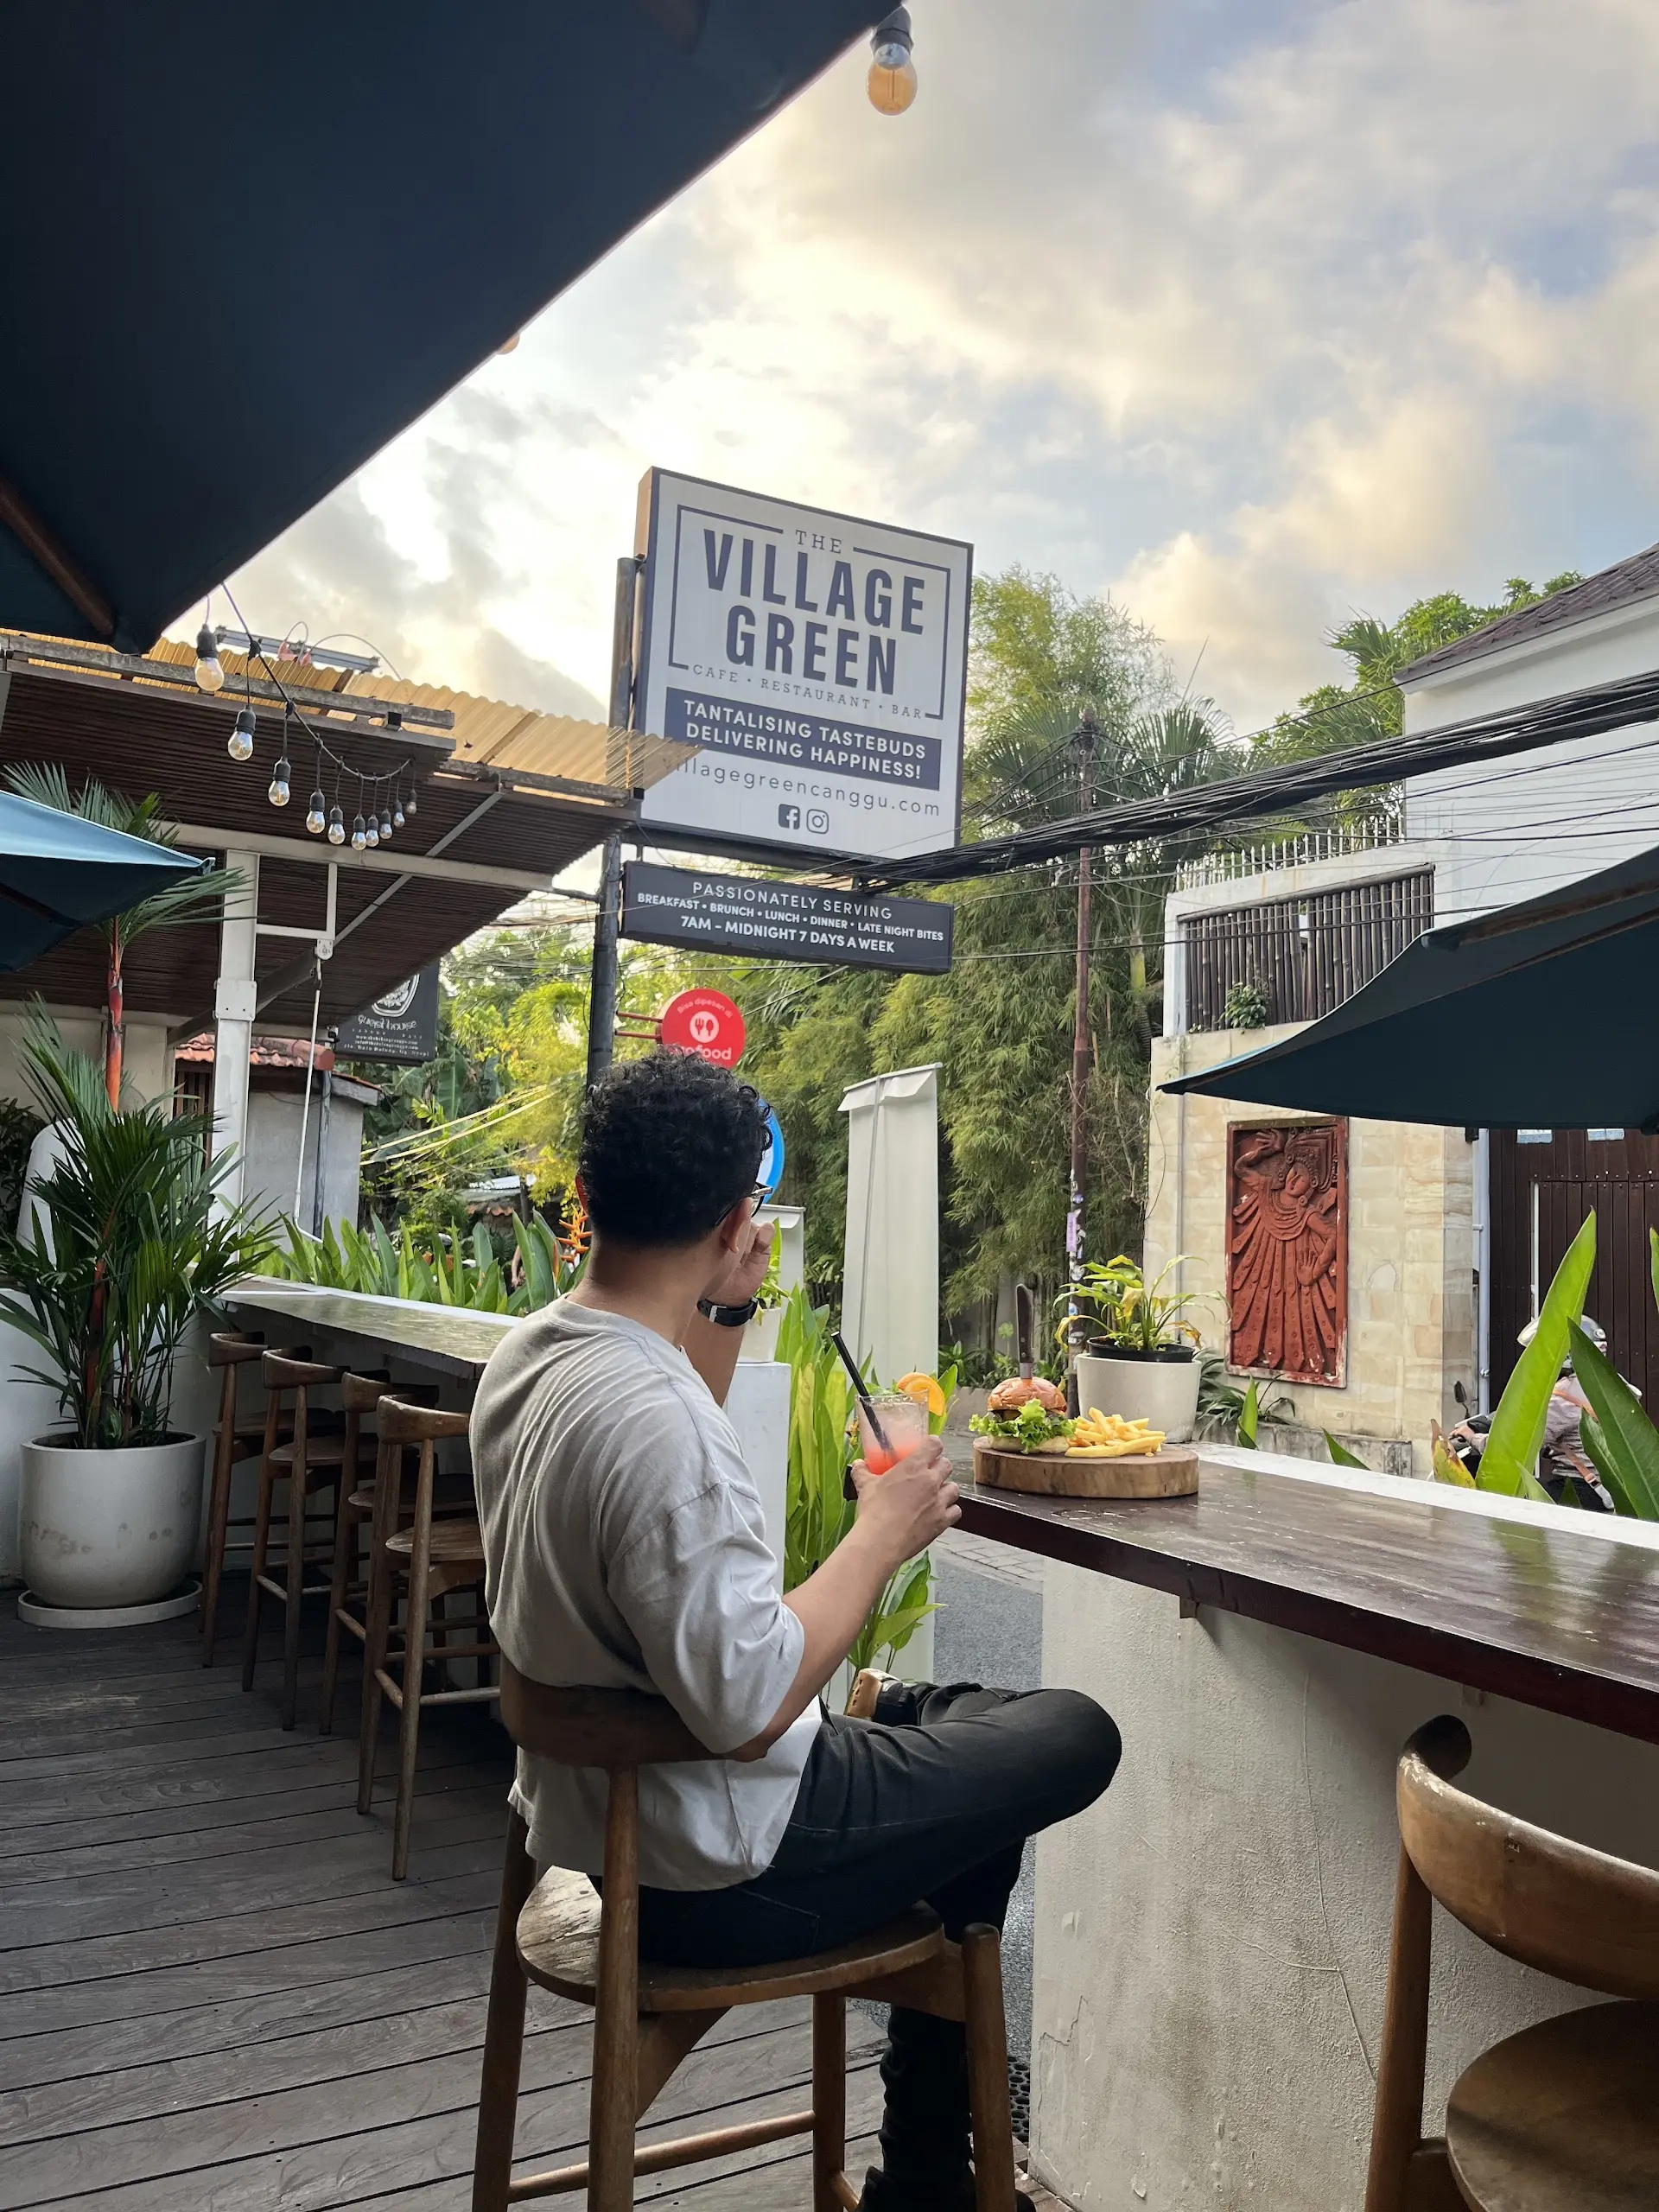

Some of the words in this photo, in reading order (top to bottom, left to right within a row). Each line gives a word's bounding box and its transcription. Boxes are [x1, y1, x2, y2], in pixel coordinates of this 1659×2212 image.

[795, 529, 842, 554] THE
[702, 528, 925, 635] VILLAGE
[725, 605, 897, 696] GREEN
[693, 664, 738, 683] CAFE
[760, 678, 871, 709] RESTAURANT
[891, 704, 922, 719] BAR
[683, 700, 812, 739] TANTALISING
[818, 727, 926, 760] TASTEBUDS
[686, 722, 804, 759] DELIVERING
[810, 747, 921, 779] HAPPINESS!
[663, 757, 939, 817] illagegreencanggu.com
[637, 893, 700, 911] BREAKFAST
[709, 903, 754, 918] BRUNCH
[765, 910, 800, 923] LUNCH
[810, 916, 848, 930] DINNER
[857, 922, 882, 934] LATE
[884, 925, 915, 938] NIGHT
[917, 930, 944, 942] BITES
[693, 881, 818, 910] PASSIONATELY
[823, 899, 893, 920] SERVING
[680, 915, 712, 931] 7AM
[725, 921, 797, 941] MIDNIGHT
[799, 931, 808, 942] 7
[810, 931, 845, 947] DAYS
[846, 937, 857, 949] A
[858, 938, 895, 953] WEEK
[675, 1044, 732, 1060] ofood
